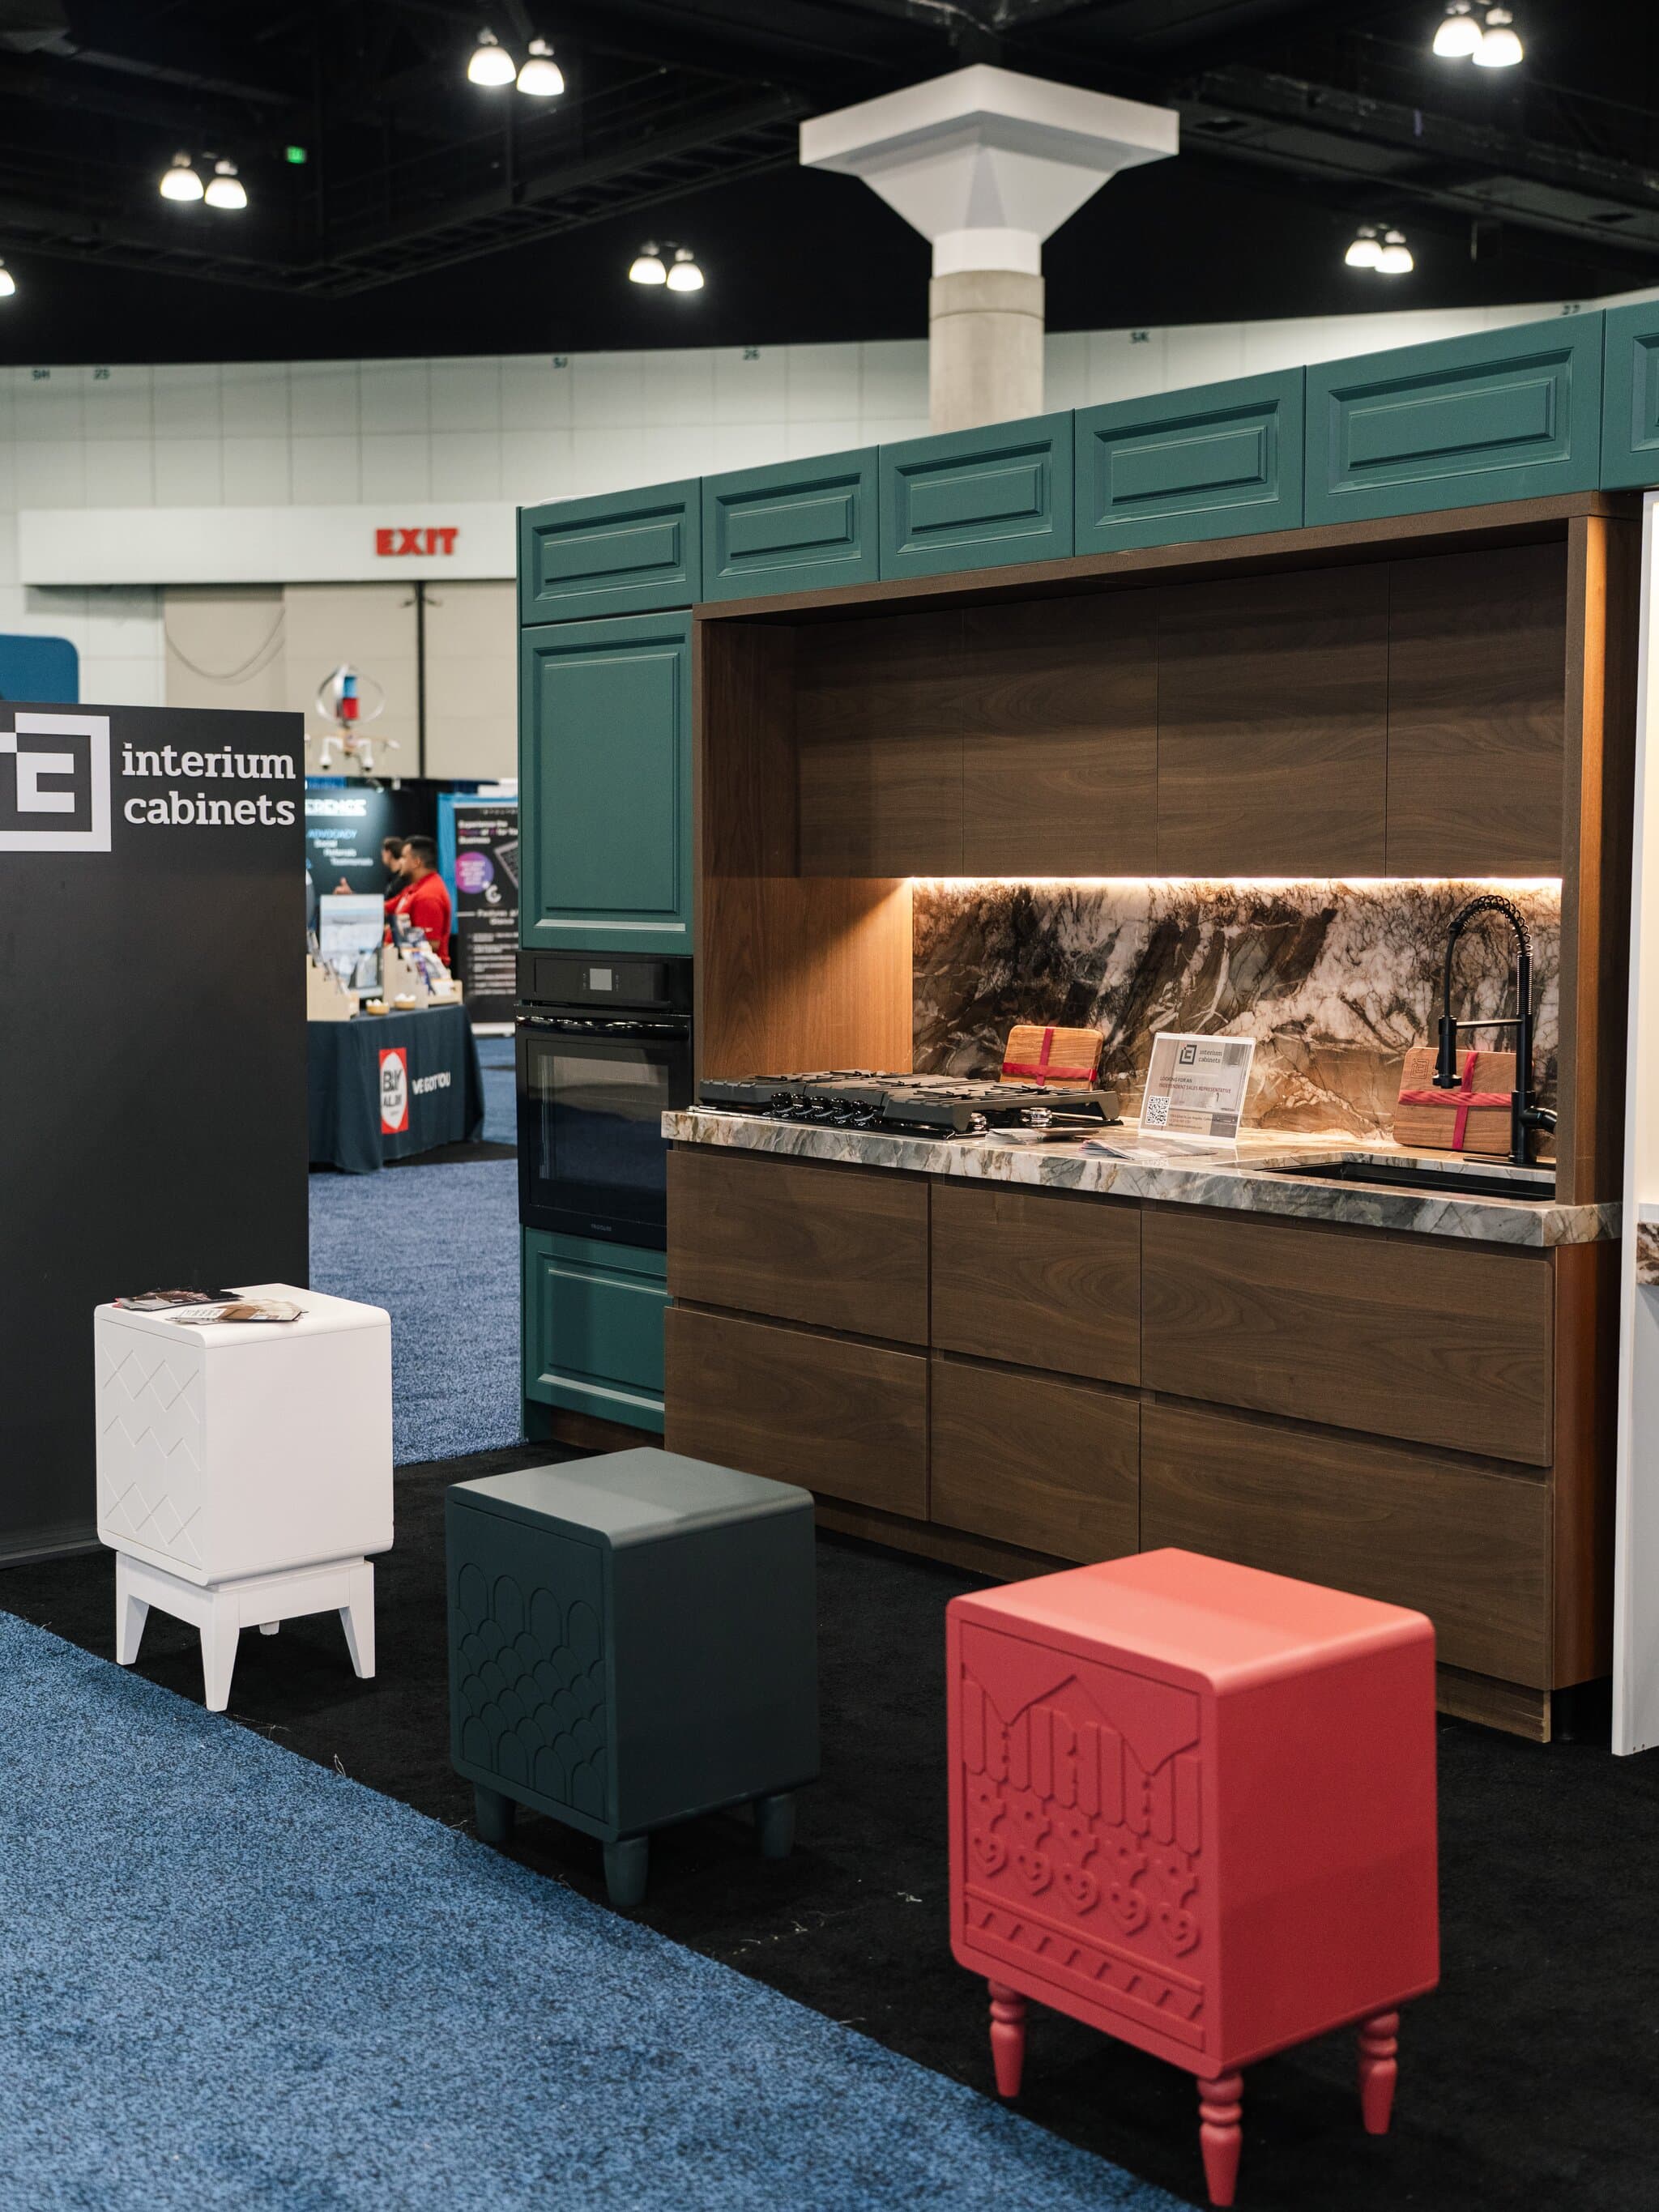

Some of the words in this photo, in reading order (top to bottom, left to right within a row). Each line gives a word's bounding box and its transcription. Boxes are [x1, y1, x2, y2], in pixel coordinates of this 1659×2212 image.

[375, 526, 458, 556] EXIT
[122, 742, 296, 780] interium
[124, 790, 296, 826] cabinets
